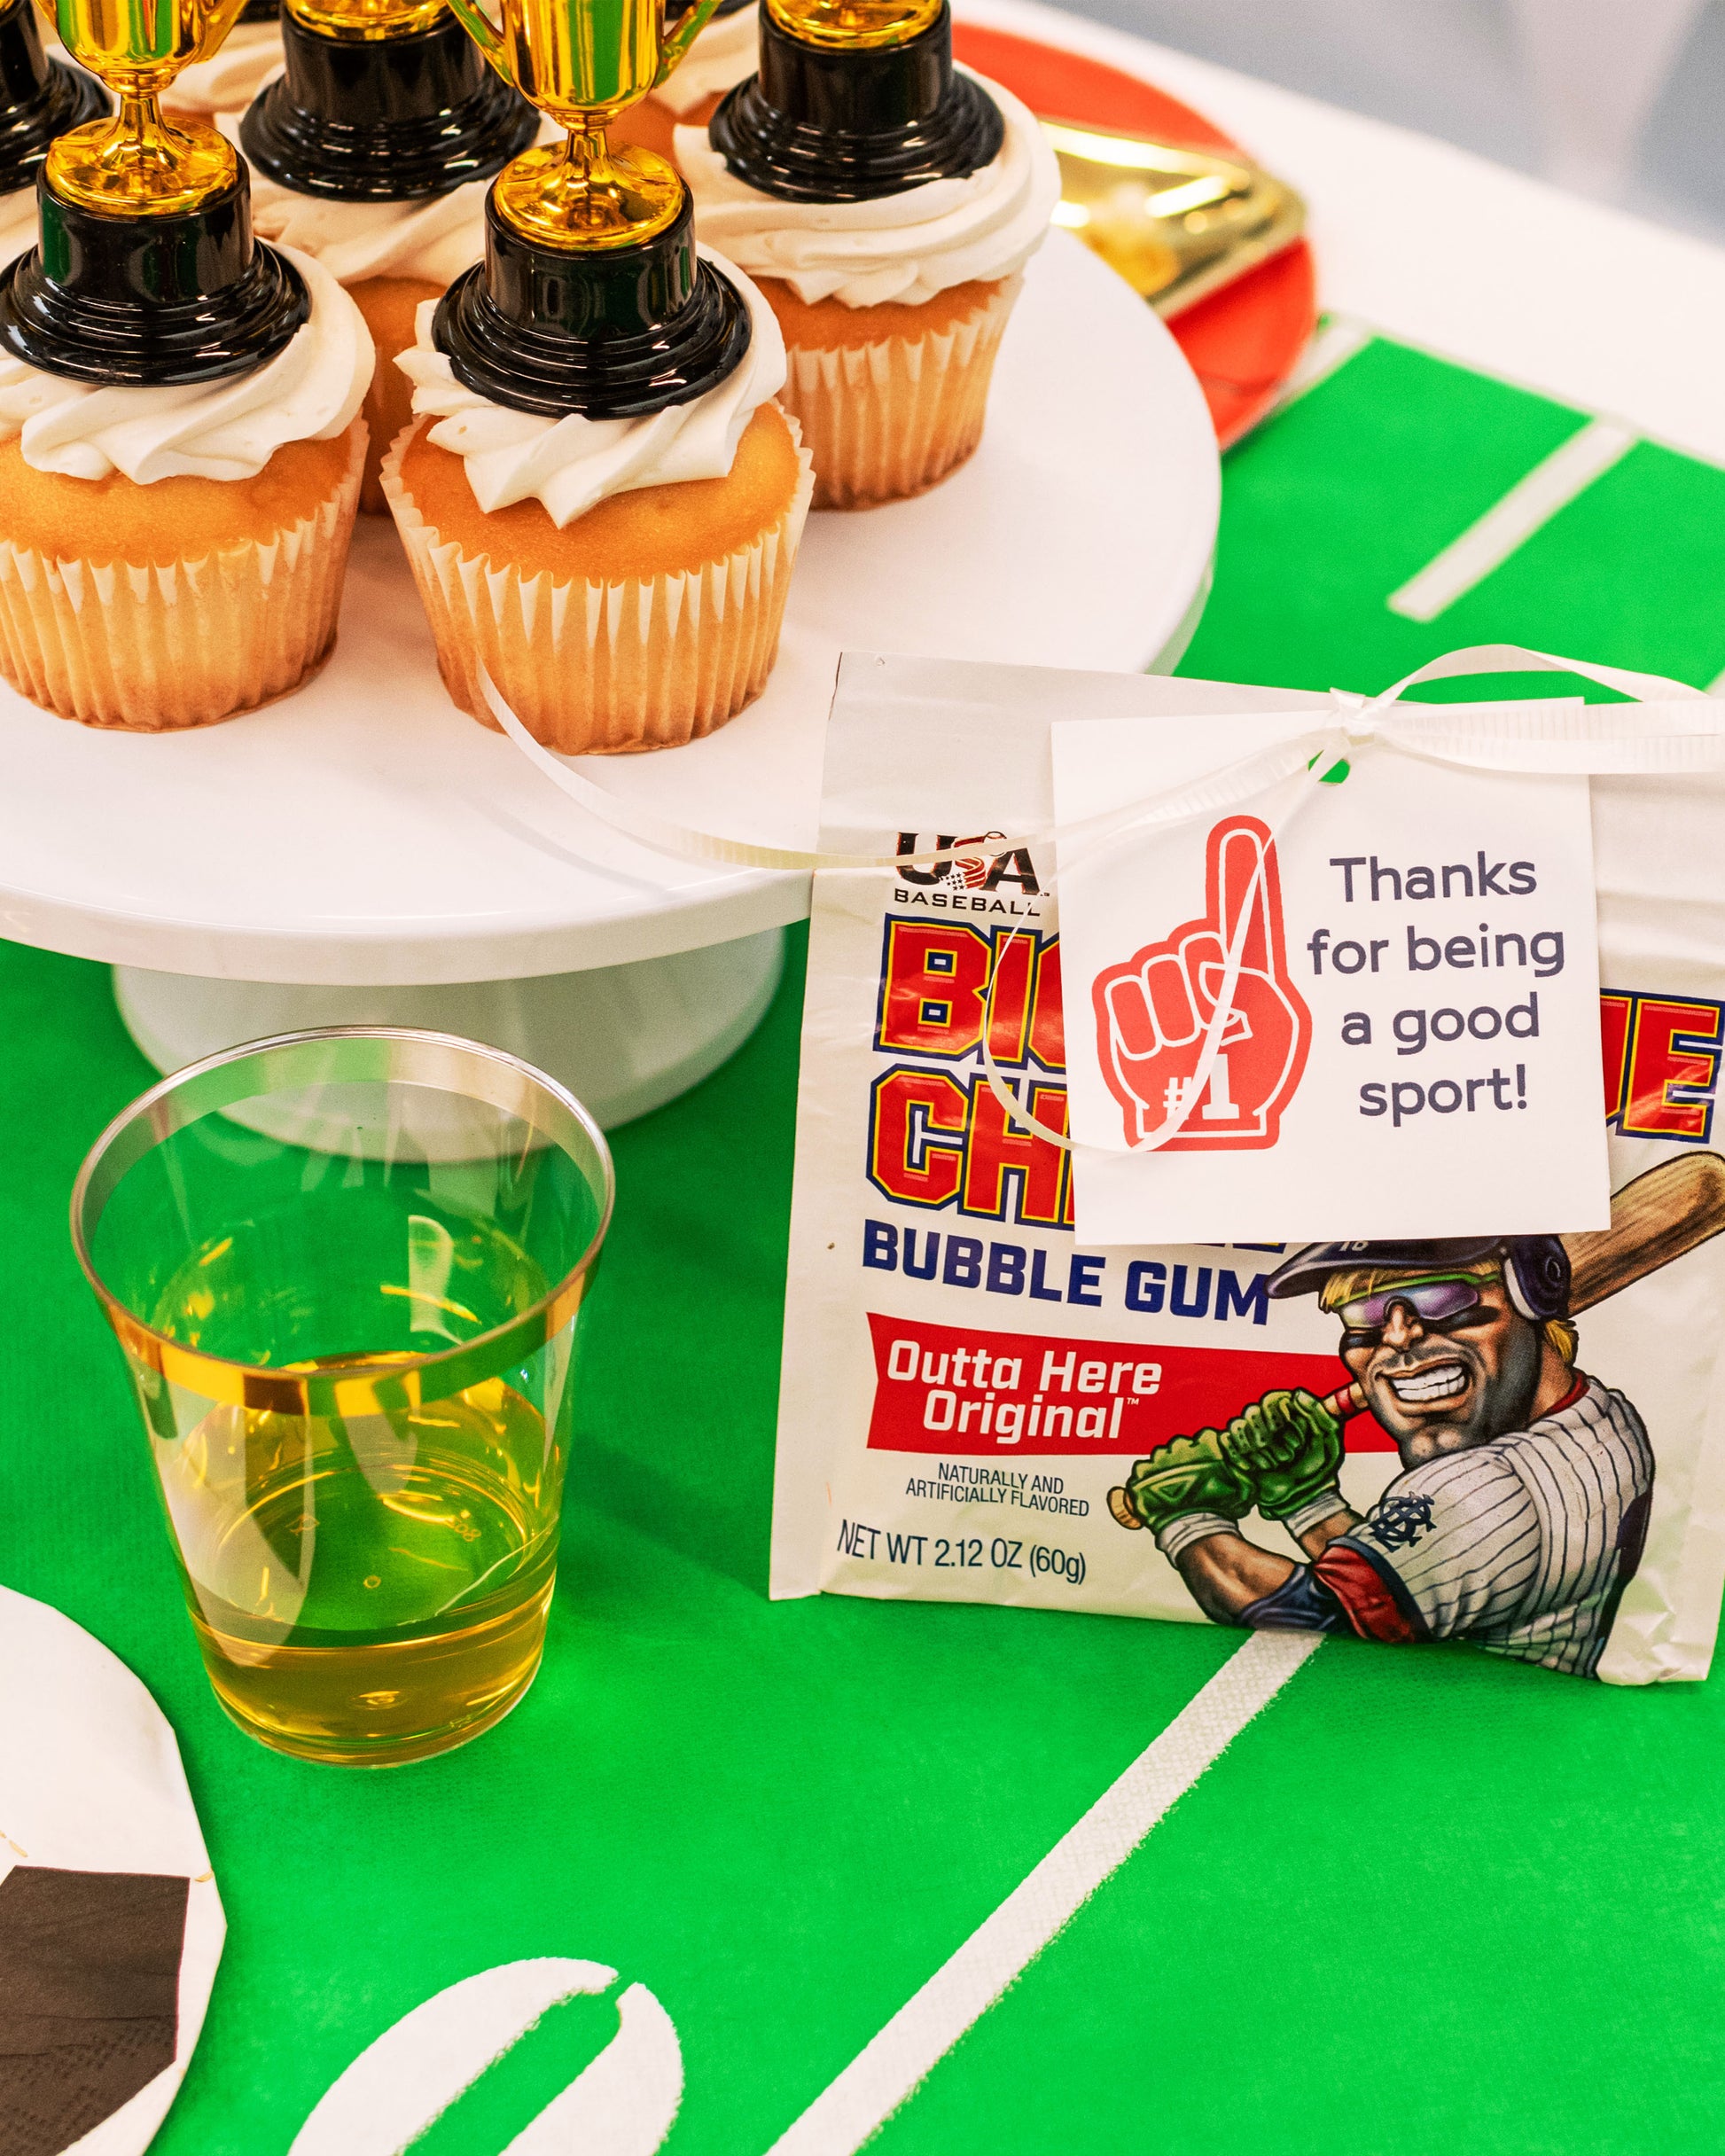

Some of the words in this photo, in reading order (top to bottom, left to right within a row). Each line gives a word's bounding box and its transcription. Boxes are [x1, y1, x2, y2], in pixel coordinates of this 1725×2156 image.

[894, 888, 1041, 917] BASEBALL
[1329, 850, 1537, 902] Thanks
[1307, 928, 1390, 975] for
[1407, 922, 1565, 977] being
[1341, 1012, 1372, 1045] a
[1393, 991, 1540, 1055] good
[1163, 1053, 1240, 1121] #1
[1359, 1063, 1527, 1128] sport!
[866, 1063, 1075, 1231] CH
[862, 1218, 1107, 1308] BUBBLE
[1124, 1259, 1270, 1325] GUM
[887, 1340, 1022, 1390] Outta
[1039, 1350, 1162, 1394] Here
[905, 1478, 1007, 1504] ARTIFICIALLY
[1011, 1491, 1089, 1517] FLAVORED
[938, 1463, 1028, 1489] NATURALLY
[1031, 1475, 1064, 1495] AND
[837, 1519, 881, 1559] NET
[886, 1532, 928, 1566] WT
[934, 1539, 982, 1566] 2.12
[990, 1537, 1023, 1568] OZ
[1030, 1544, 1086, 1585] (60g)
